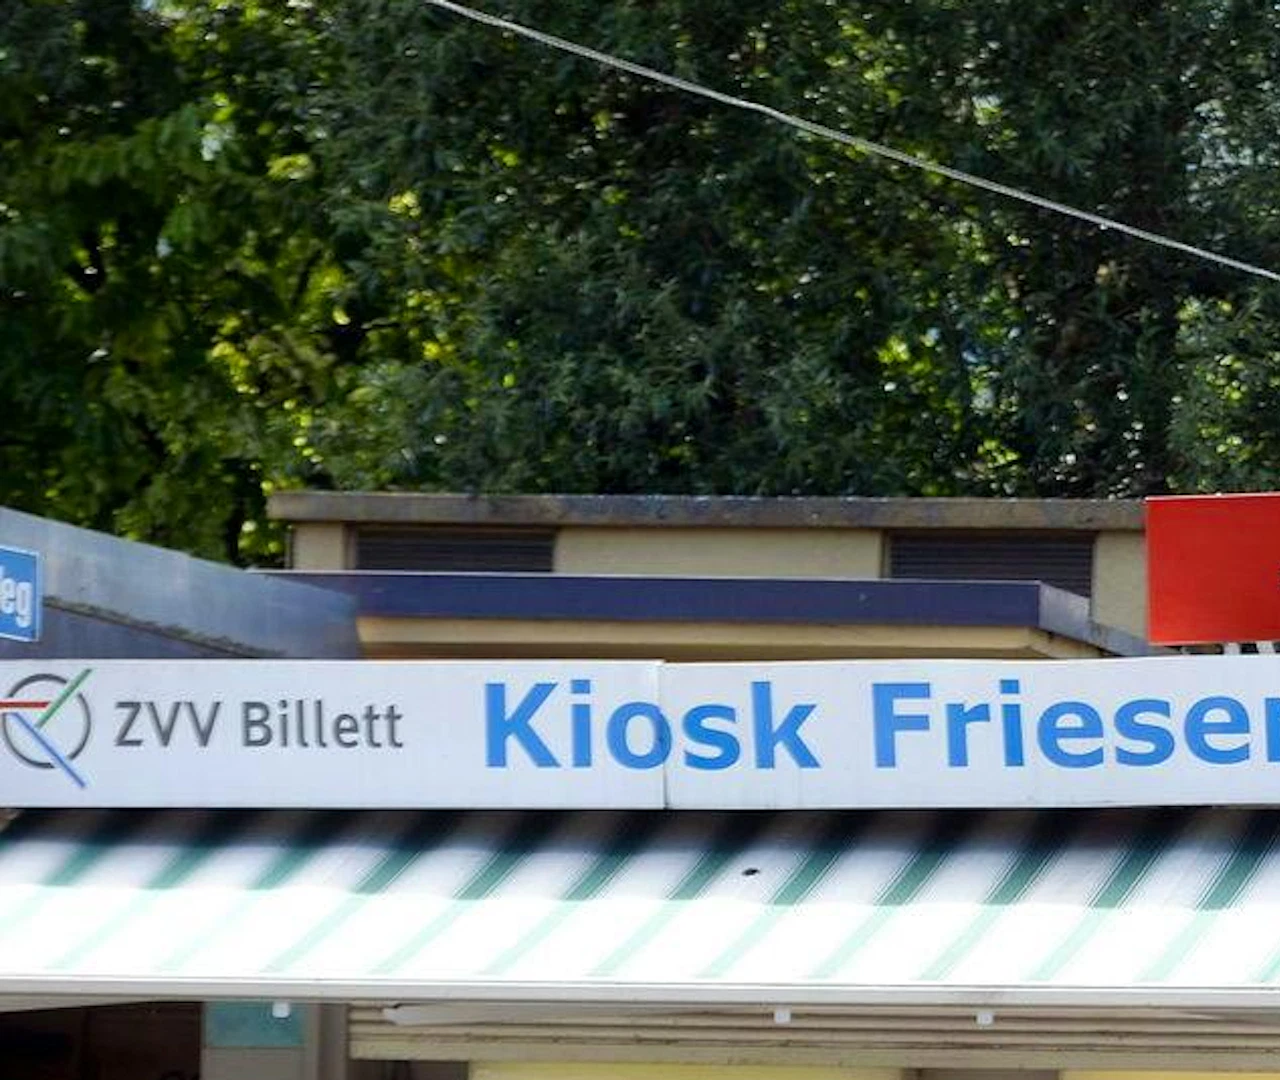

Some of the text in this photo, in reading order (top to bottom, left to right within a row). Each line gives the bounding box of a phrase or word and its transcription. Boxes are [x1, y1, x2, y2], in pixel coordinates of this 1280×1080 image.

[0, 565, 32, 628] eg
[114, 699, 404, 750] ZVV Billett
[485, 679, 822, 771] Kiosk
